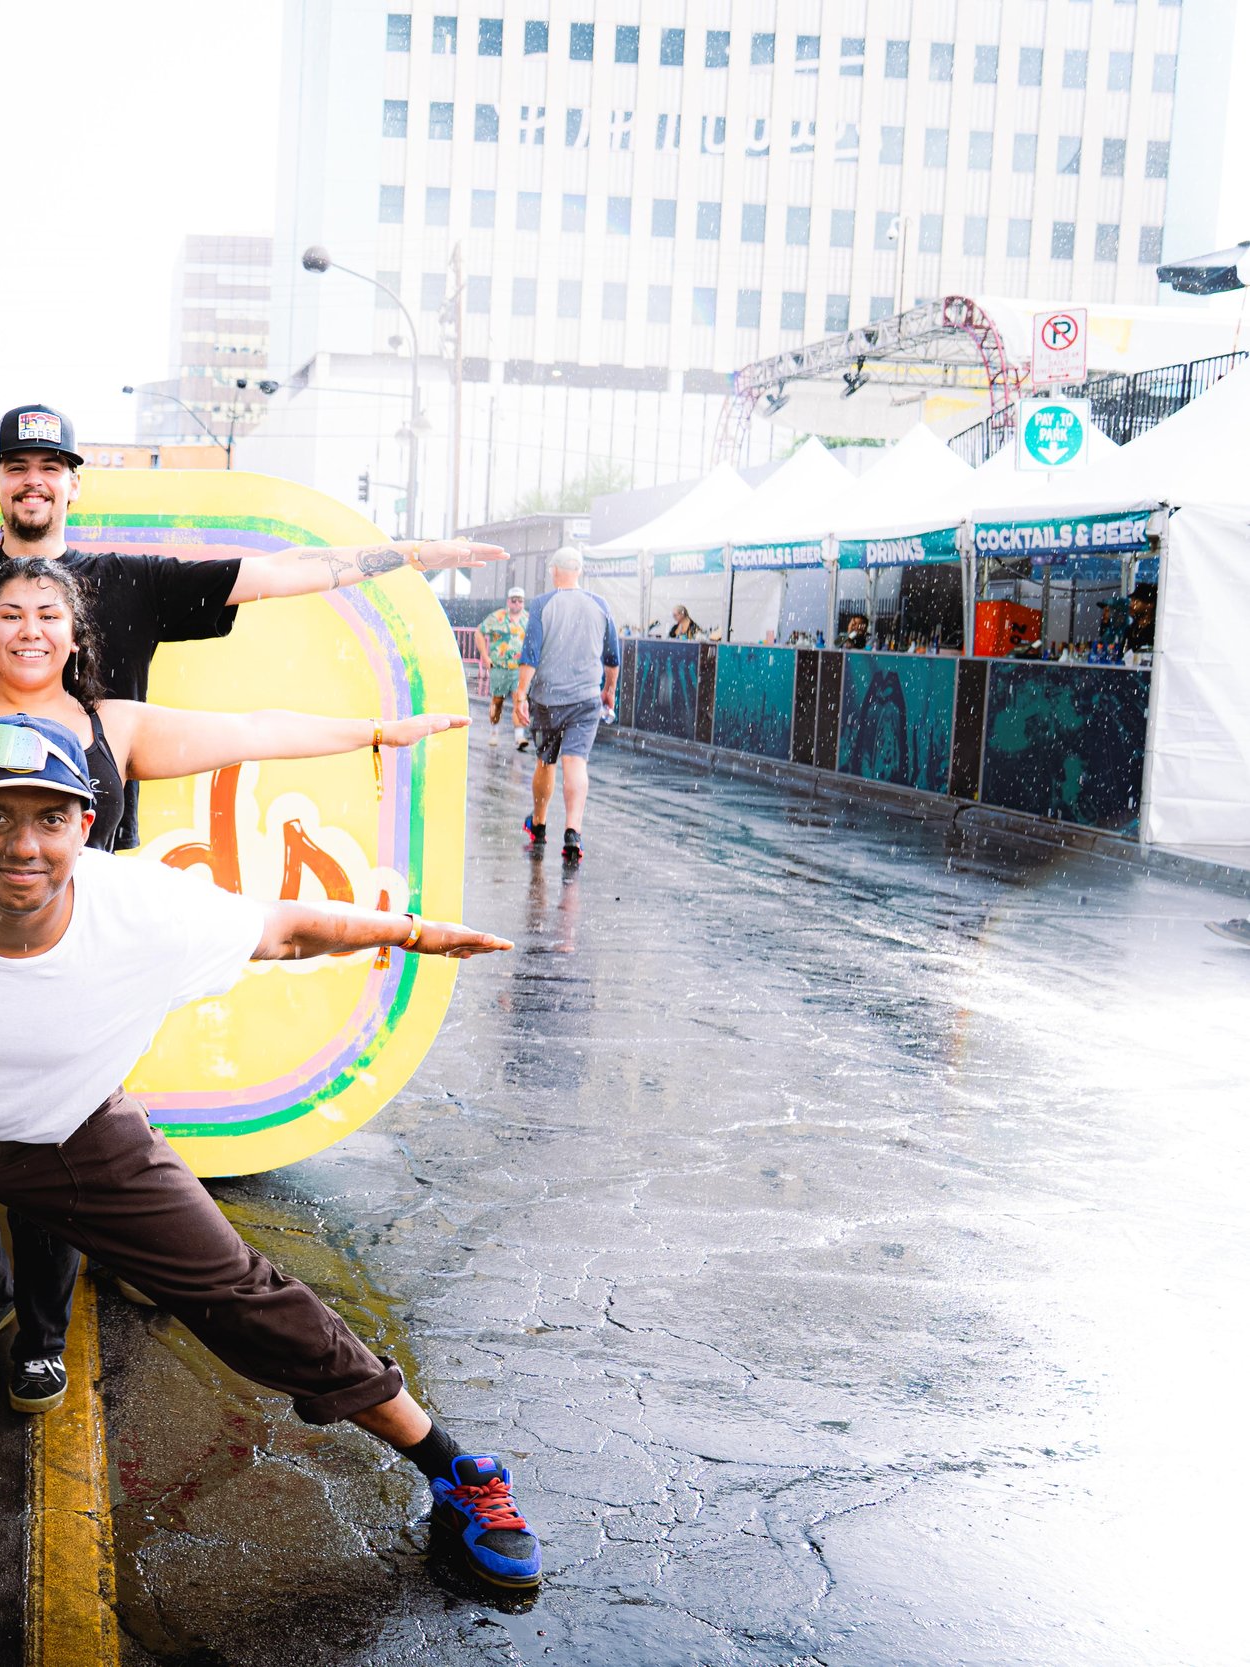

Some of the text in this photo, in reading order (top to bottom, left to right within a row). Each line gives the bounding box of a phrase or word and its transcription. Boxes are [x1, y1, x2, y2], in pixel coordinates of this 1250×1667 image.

[1035, 412, 1074, 427] PAY TO
[20, 430, 59, 441] RODEO
[1039, 428, 1068, 441] PARK
[976, 520, 1146, 551] COCKTAILS & BEER
[732, 547, 783, 566] COCKTAILS
[792, 546, 822, 564] BEER
[865, 538, 925, 563] DRINKS
[670, 553, 705, 572] DRINKS
